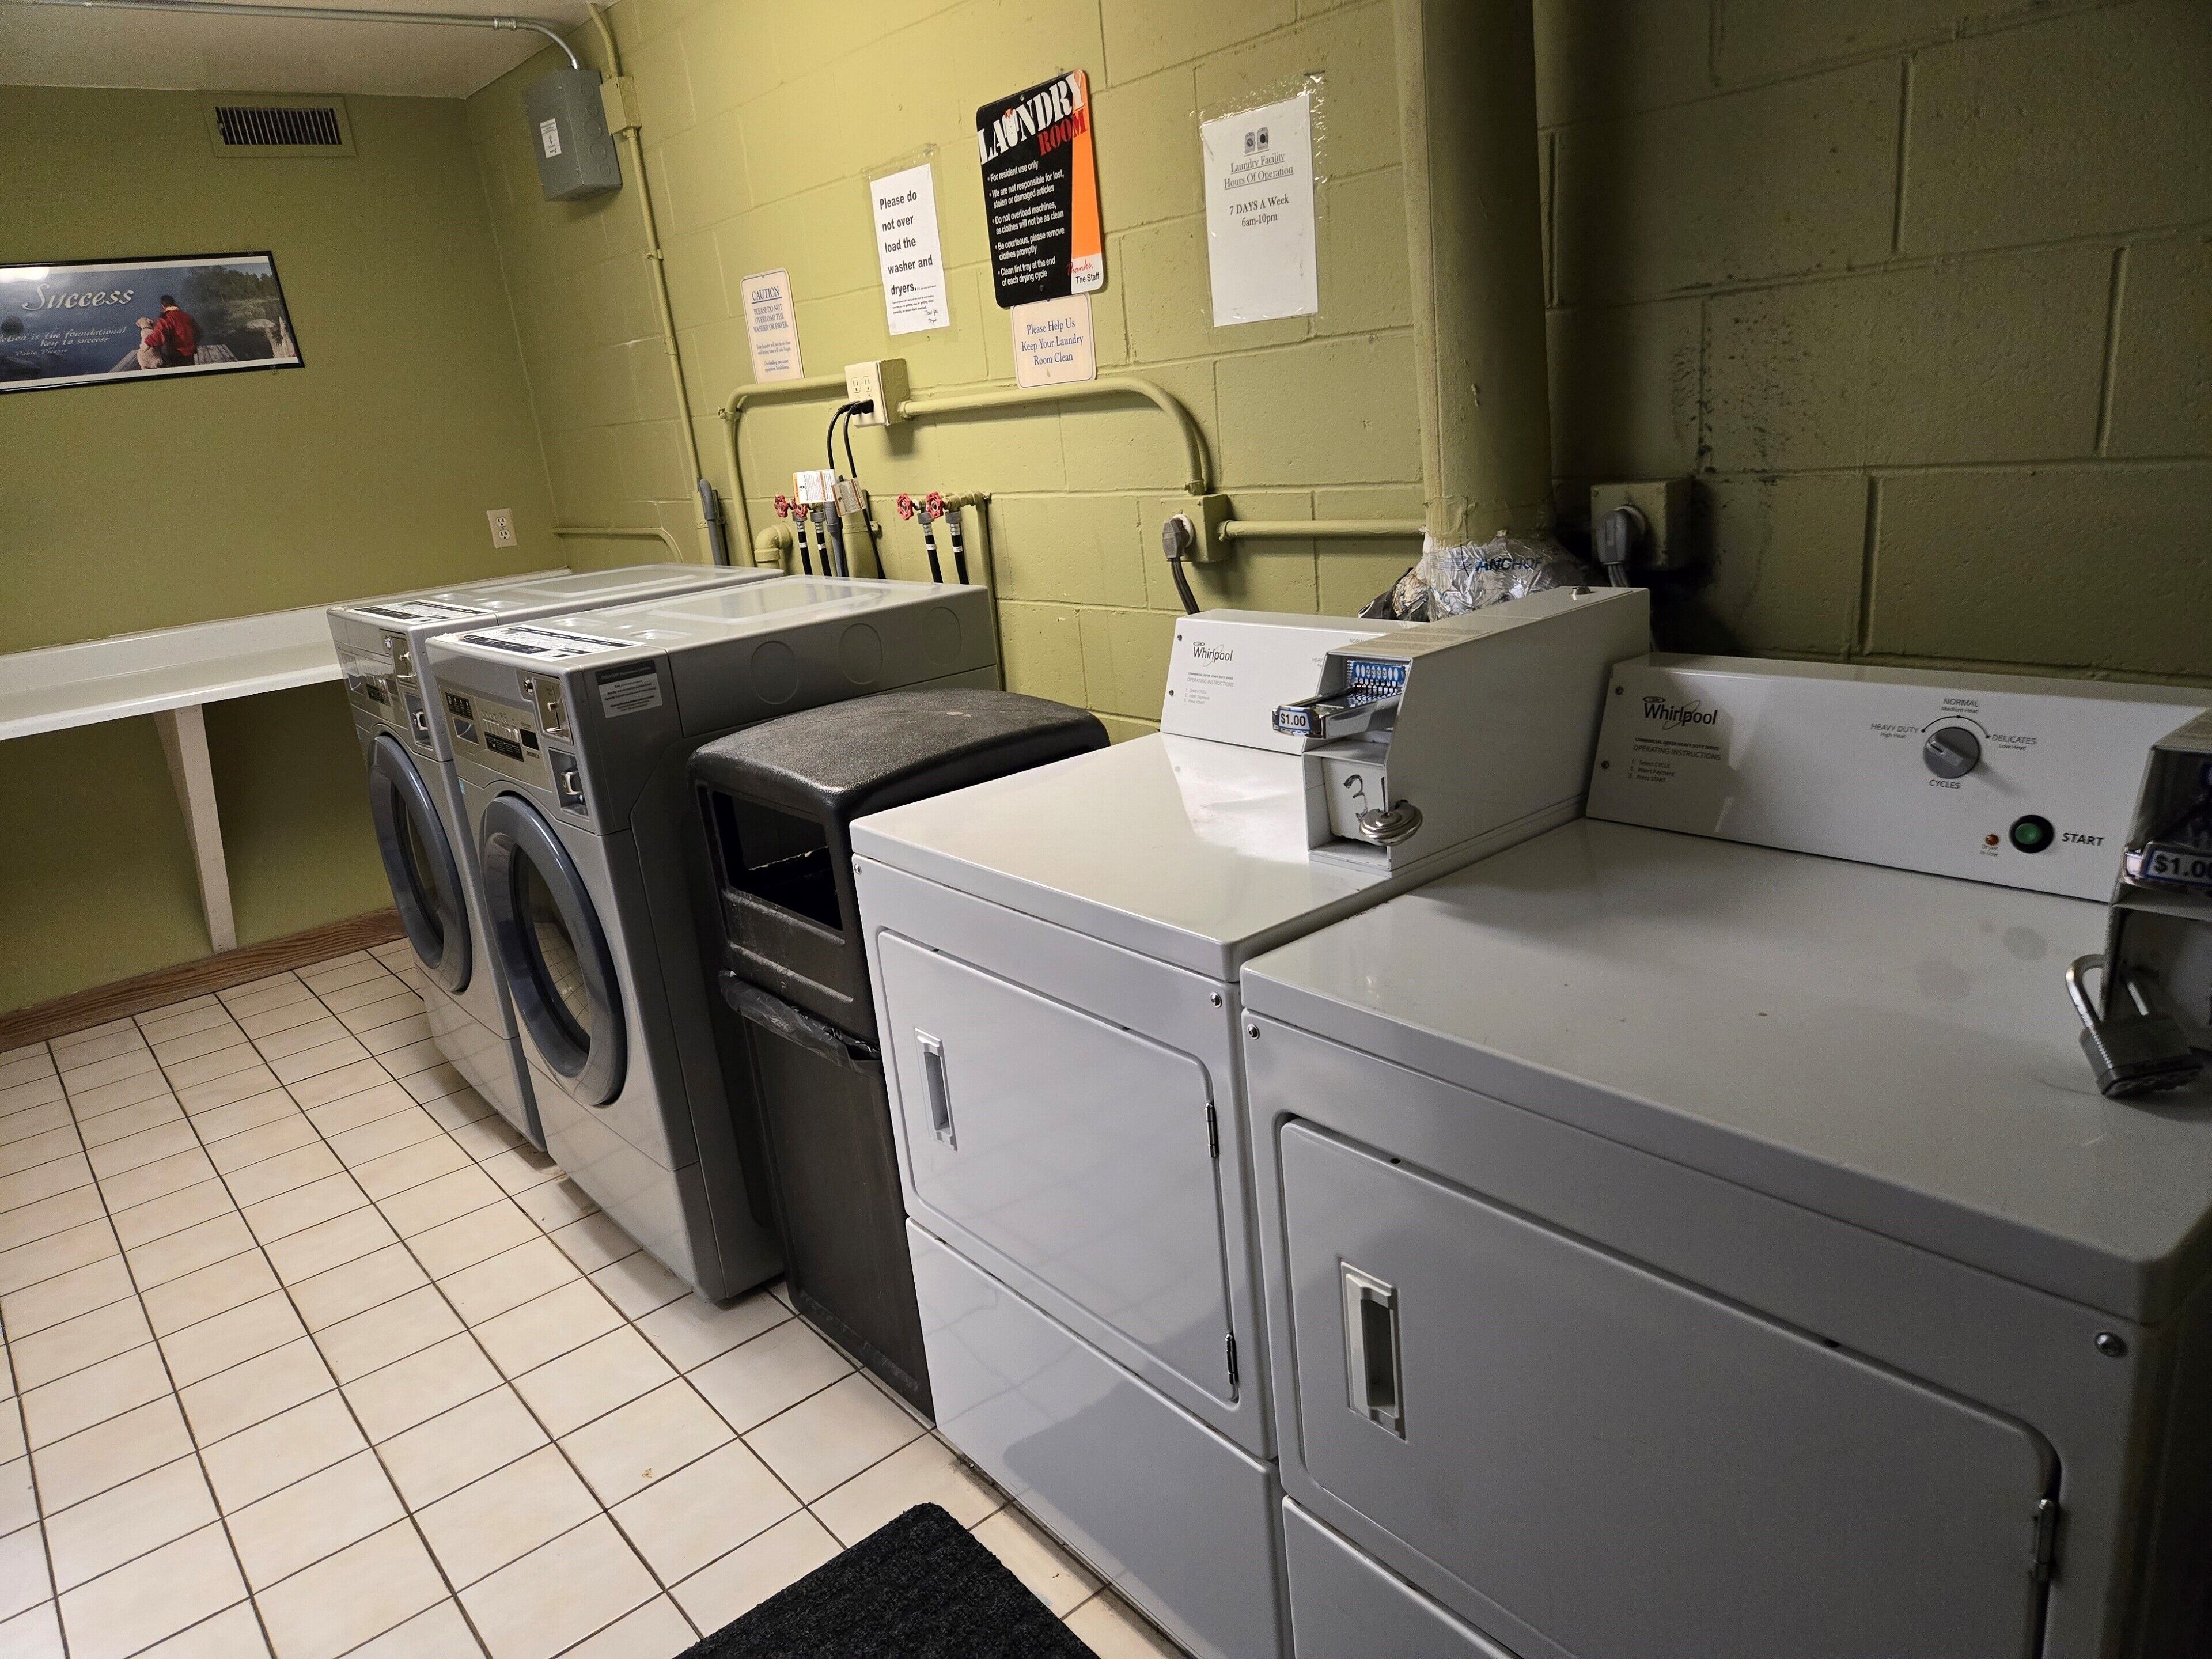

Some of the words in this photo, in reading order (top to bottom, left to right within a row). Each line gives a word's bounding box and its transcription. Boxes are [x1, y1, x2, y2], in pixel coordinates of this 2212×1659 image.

[1037, 109, 1086, 156] ROOM
[1230, 158, 1259, 172] Laundry
[1260, 152, 1285, 165] Facility
[990, 173, 998, 183] For
[999, 166, 1018, 180] resident
[1018, 164, 1027, 173] use
[1028, 160, 1039, 170] only
[1224, 177, 1245, 188] Hours
[1247, 172, 1257, 183] Of
[1257, 166, 1293, 181] Operation
[991, 188, 999, 198] We
[1008, 184, 1016, 193] not
[1017, 175, 1044, 191] responsible
[1052, 169, 1064, 179] lost,
[880, 195, 904, 210] Please
[907, 190, 917, 202] do
[993, 198, 1007, 209] stolen
[1014, 188, 1036, 203] damaged
[1036, 184, 1054, 196] articles
[1229, 206, 1234, 215] 7
[1236, 200, 1258, 214] DAYS
[1259, 199, 1266, 210] A
[1267, 194, 1290, 207] Week
[995, 215, 1002, 225] Do
[1002, 213, 1010, 222] not
[1010, 207, 1031, 219] overload
[1032, 202, 1056, 214] machines,
[1002, 223, 1018, 233] clothes
[1018, 219, 1028, 229] will
[1028, 217, 1036, 226] not
[1036, 215, 1043, 224] be
[1043, 214, 1050, 222] as
[1050, 210, 1064, 220] clean
[1241, 213, 1278, 227] 6am-10pm
[882, 219, 895, 232] not
[897, 215, 914, 228] over
[885, 239, 902, 253] load
[903, 237, 916, 249] the
[998, 241, 1005, 251] Be
[1005, 236, 1030, 249] courteous,
[1029, 232, 1046, 244] please
[1046, 227, 1065, 238] remove
[999, 250, 1016, 261] clothes
[1016, 244, 1037, 259] promptly
[888, 260, 915, 274] washer
[918, 254, 933, 268] and
[1001, 266, 1014, 276] Clean
[1014, 264, 1022, 273] lint
[1022, 262, 1032, 272] tray
[1032, 260, 1037, 269] at
[1037, 259, 1046, 268] the
[1046, 256, 1056, 266] end
[1002, 278, 1007, 286] of
[1007, 275, 1019, 285] each
[1019, 273, 1035, 283] drying
[1035, 269, 1047, 281] cycle
[1075, 276, 1086, 284] The
[1087, 272, 1099, 282] Staff
[22, 283, 134, 310] Success
[752, 286, 779, 301] CAUTION
[891, 283, 916, 297] dryers.
[753, 306, 767, 315] PLEASE
[774, 304, 782, 312] NOT
[755, 314, 775, 324] OVERLOAD
[1027, 324, 1046, 335] Please
[1047, 319, 1064, 332] Help
[1065, 317, 1075, 328] Us
[65, 326, 127, 340] foundational
[753, 324, 769, 332] WASHER
[1021, 341, 1037, 352] Keep
[1039, 338, 1054, 349] Your
[1055, 334, 1084, 347] Laundry
[1033, 355, 1052, 366] Room
[1054, 352, 1073, 363] Clean
[1194, 646, 1233, 663] Whirlpool
[1943, 698, 1979, 707] NORMAL
[1281, 712, 1306, 726] $1.00
[1645, 703, 1718, 726] Whirlpool
[1871, 723, 1896, 732] HEAVY
[1897, 725, 1919, 733] DUTY
[1991, 734, 2036, 745] DELICATES
[1634, 744, 1669, 755] OPERATING
[1671, 748, 1722, 760] INSTRUCTIONS
[1929, 779, 1961, 789] CYCLES
[1343, 774, 1368, 822] 3
[2062, 832, 2104, 846] START
